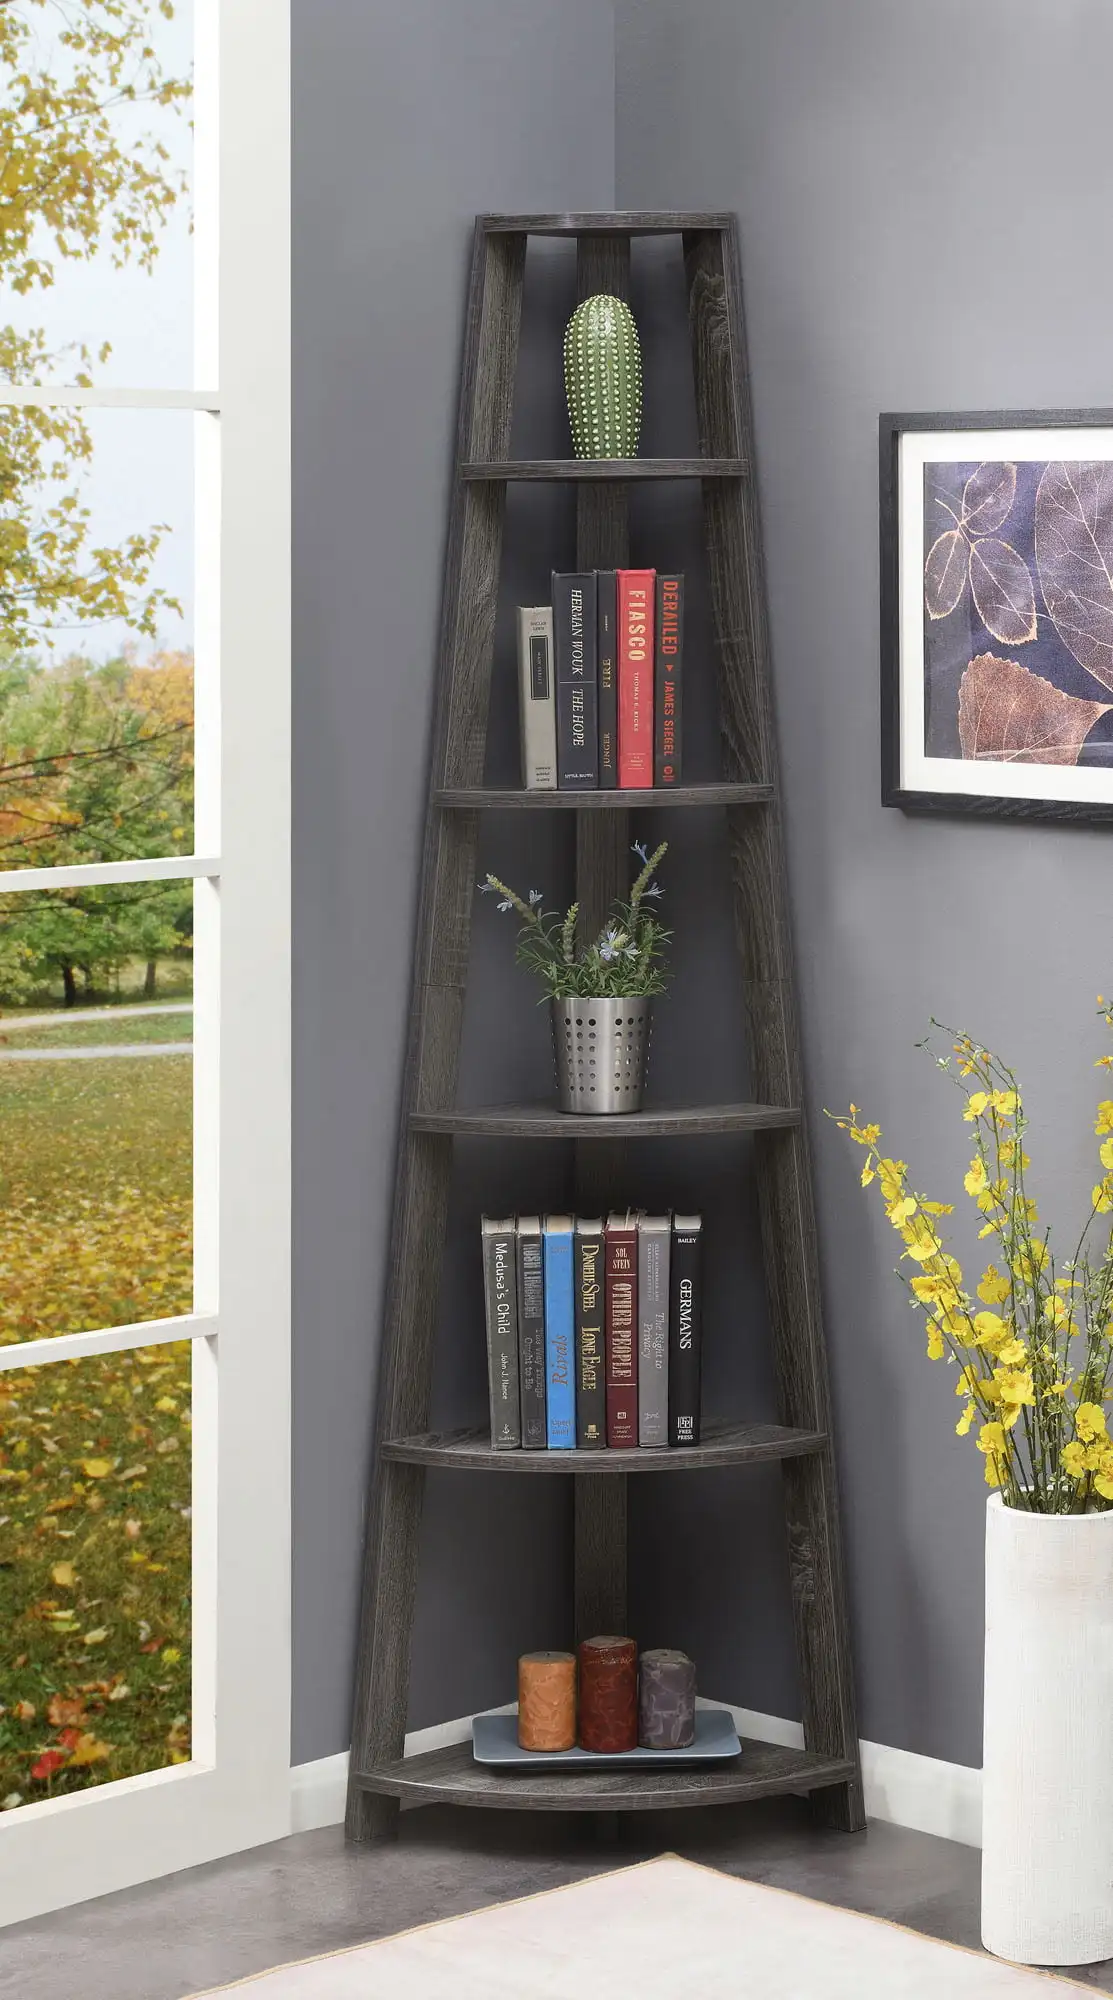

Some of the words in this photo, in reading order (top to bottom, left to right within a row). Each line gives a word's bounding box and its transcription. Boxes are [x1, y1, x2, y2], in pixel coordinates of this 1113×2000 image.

[571, 588, 583, 637] HERMAN
[628, 589, 646, 662] FIASCO
[662, 581, 678, 655] DERAILED
[571, 640, 584, 676] WOUK
[602, 657, 612, 689] FIRE
[571, 688, 584, 714] THE
[664, 680, 674, 716] JAMES
[572, 715, 585, 747] HOPE
[663, 719, 674, 757] SIEGEL
[603, 732, 611, 768] JUNGER
[581, 1244, 599, 1284] DANIELLE
[612, 1258, 631, 1269] STEIN
[615, 1247, 627, 1257] SOL
[494, 1242, 507, 1299] Medusa's
[581, 1283, 600, 1312] STEEL
[611, 1282, 632, 1327] OTHER
[679, 1278, 693, 1350] GERMANS
[496, 1302, 511, 1334] Child
[655, 1312, 664, 1330] The
[581, 1326, 600, 1355] LONE
[611, 1330, 632, 1378] PEOPLE
[641, 1322, 653, 1359] Privacy
[652, 1332, 664, 1359] Right
[500, 1352, 508, 1370] John
[552, 1334, 568, 1386] Rivals
[582, 1355, 601, 1391] EAGLE
[655, 1360, 663, 1369] to
